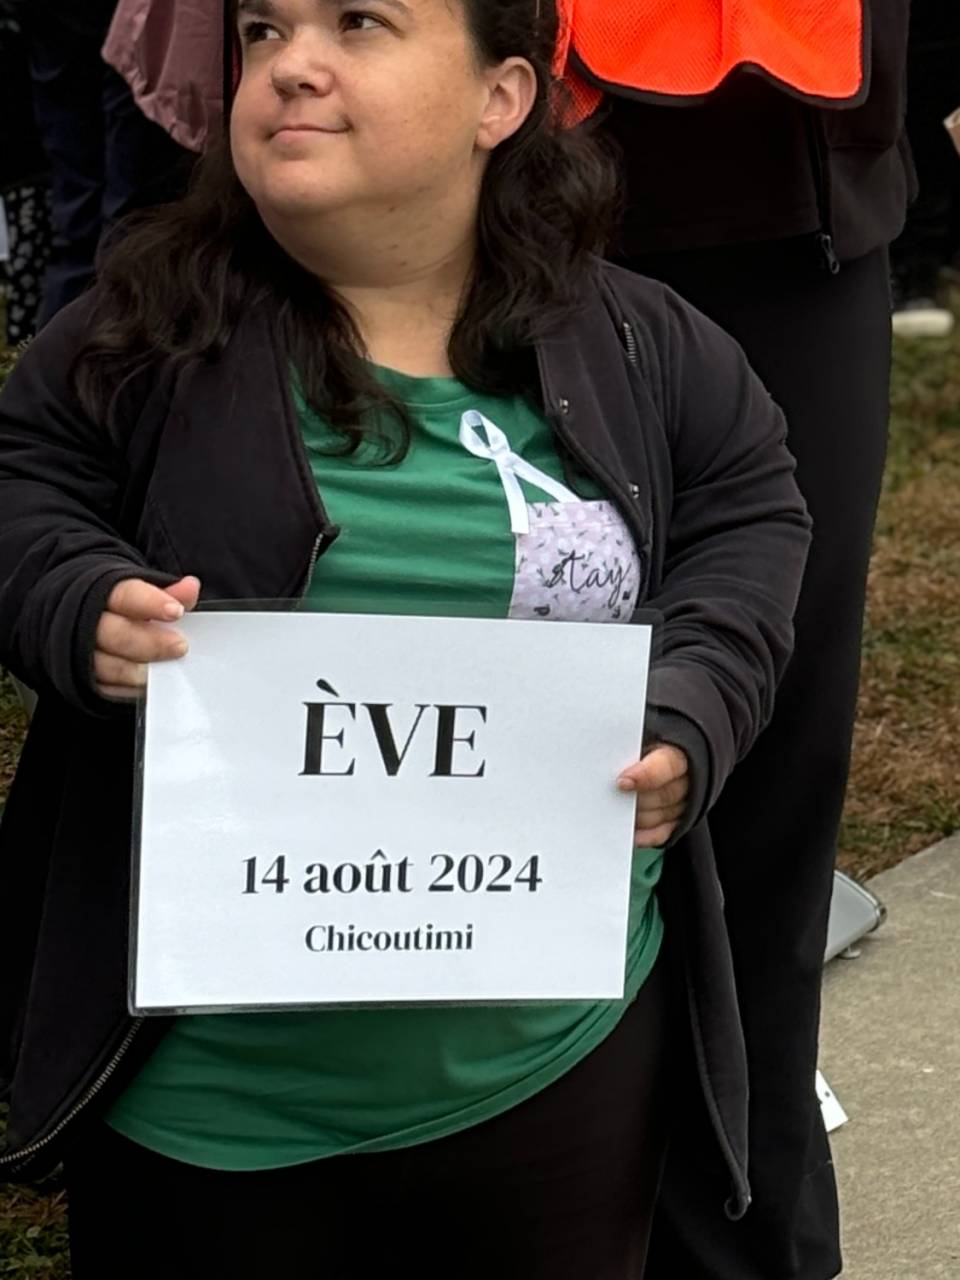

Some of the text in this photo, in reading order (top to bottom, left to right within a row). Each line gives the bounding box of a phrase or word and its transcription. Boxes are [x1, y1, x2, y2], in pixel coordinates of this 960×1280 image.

[298, 677, 488, 778] ÈVE
[241, 848, 543, 895] 14 août 2024
[305, 924, 474, 952] Chicoutimi
